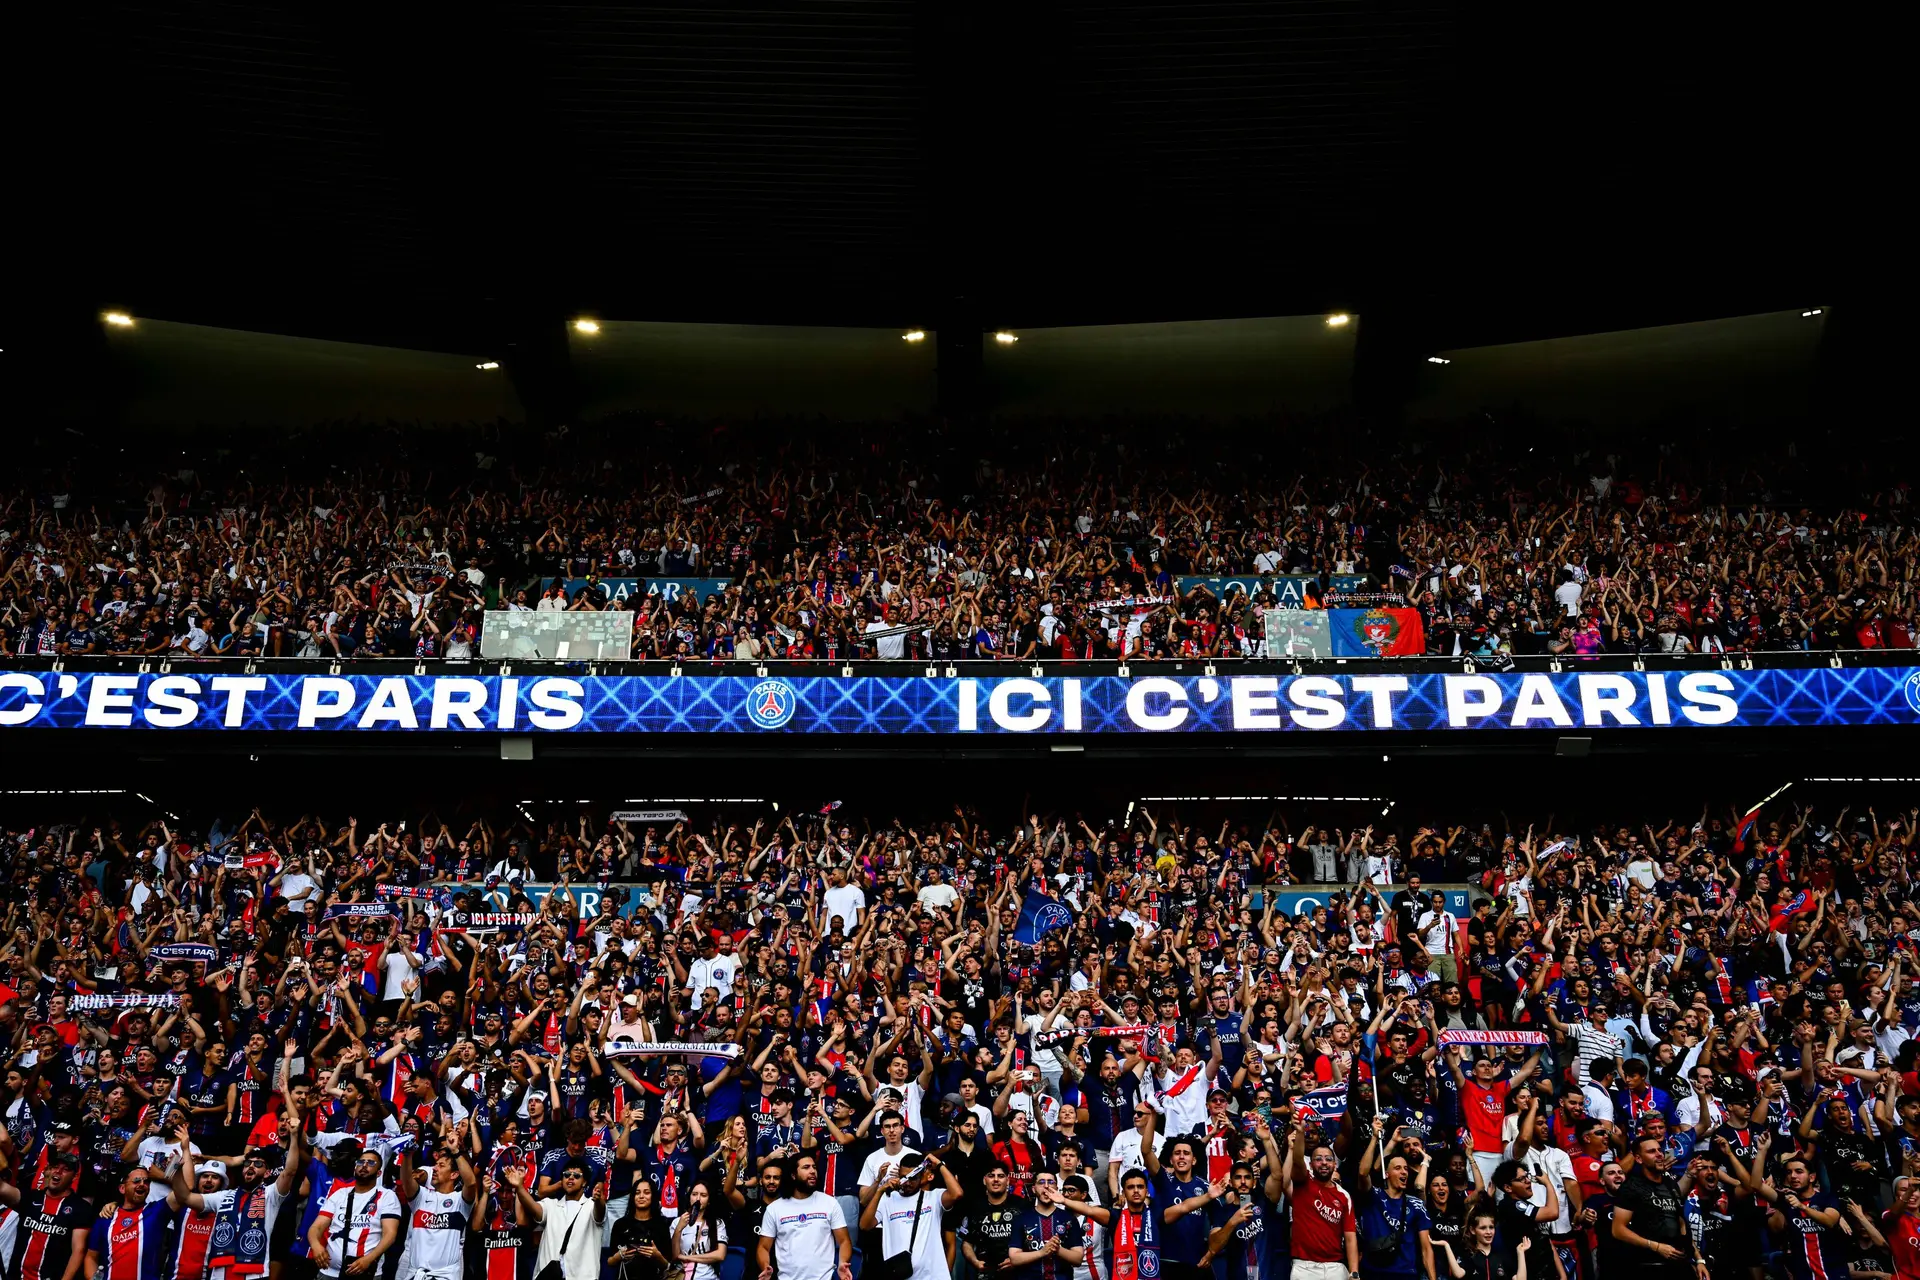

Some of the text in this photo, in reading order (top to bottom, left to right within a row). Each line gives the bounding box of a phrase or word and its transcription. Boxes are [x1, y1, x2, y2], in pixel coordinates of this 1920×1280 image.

[756, 683, 787, 696] PARIS
[0, 673, 585, 731] C'EST PARIS
[958, 672, 1738, 732] ICI C'EST PARIS
[471, 913, 482, 924] ICI
[486, 913, 512, 924] C'EST
[1314, 1199, 1342, 1218] QATAR
[40, 1213, 54, 1223] Fly
[421, 1213, 449, 1223] QATAR
[23, 1216, 67, 1235] Emirates
[981, 1223, 1011, 1234] QATAR
[1236, 1218, 1263, 1239] QATAR
[1436, 1224, 1459, 1232] QATAR
[112, 1230, 137, 1242] QATAR
[485, 1238, 522, 1248] Emirates
